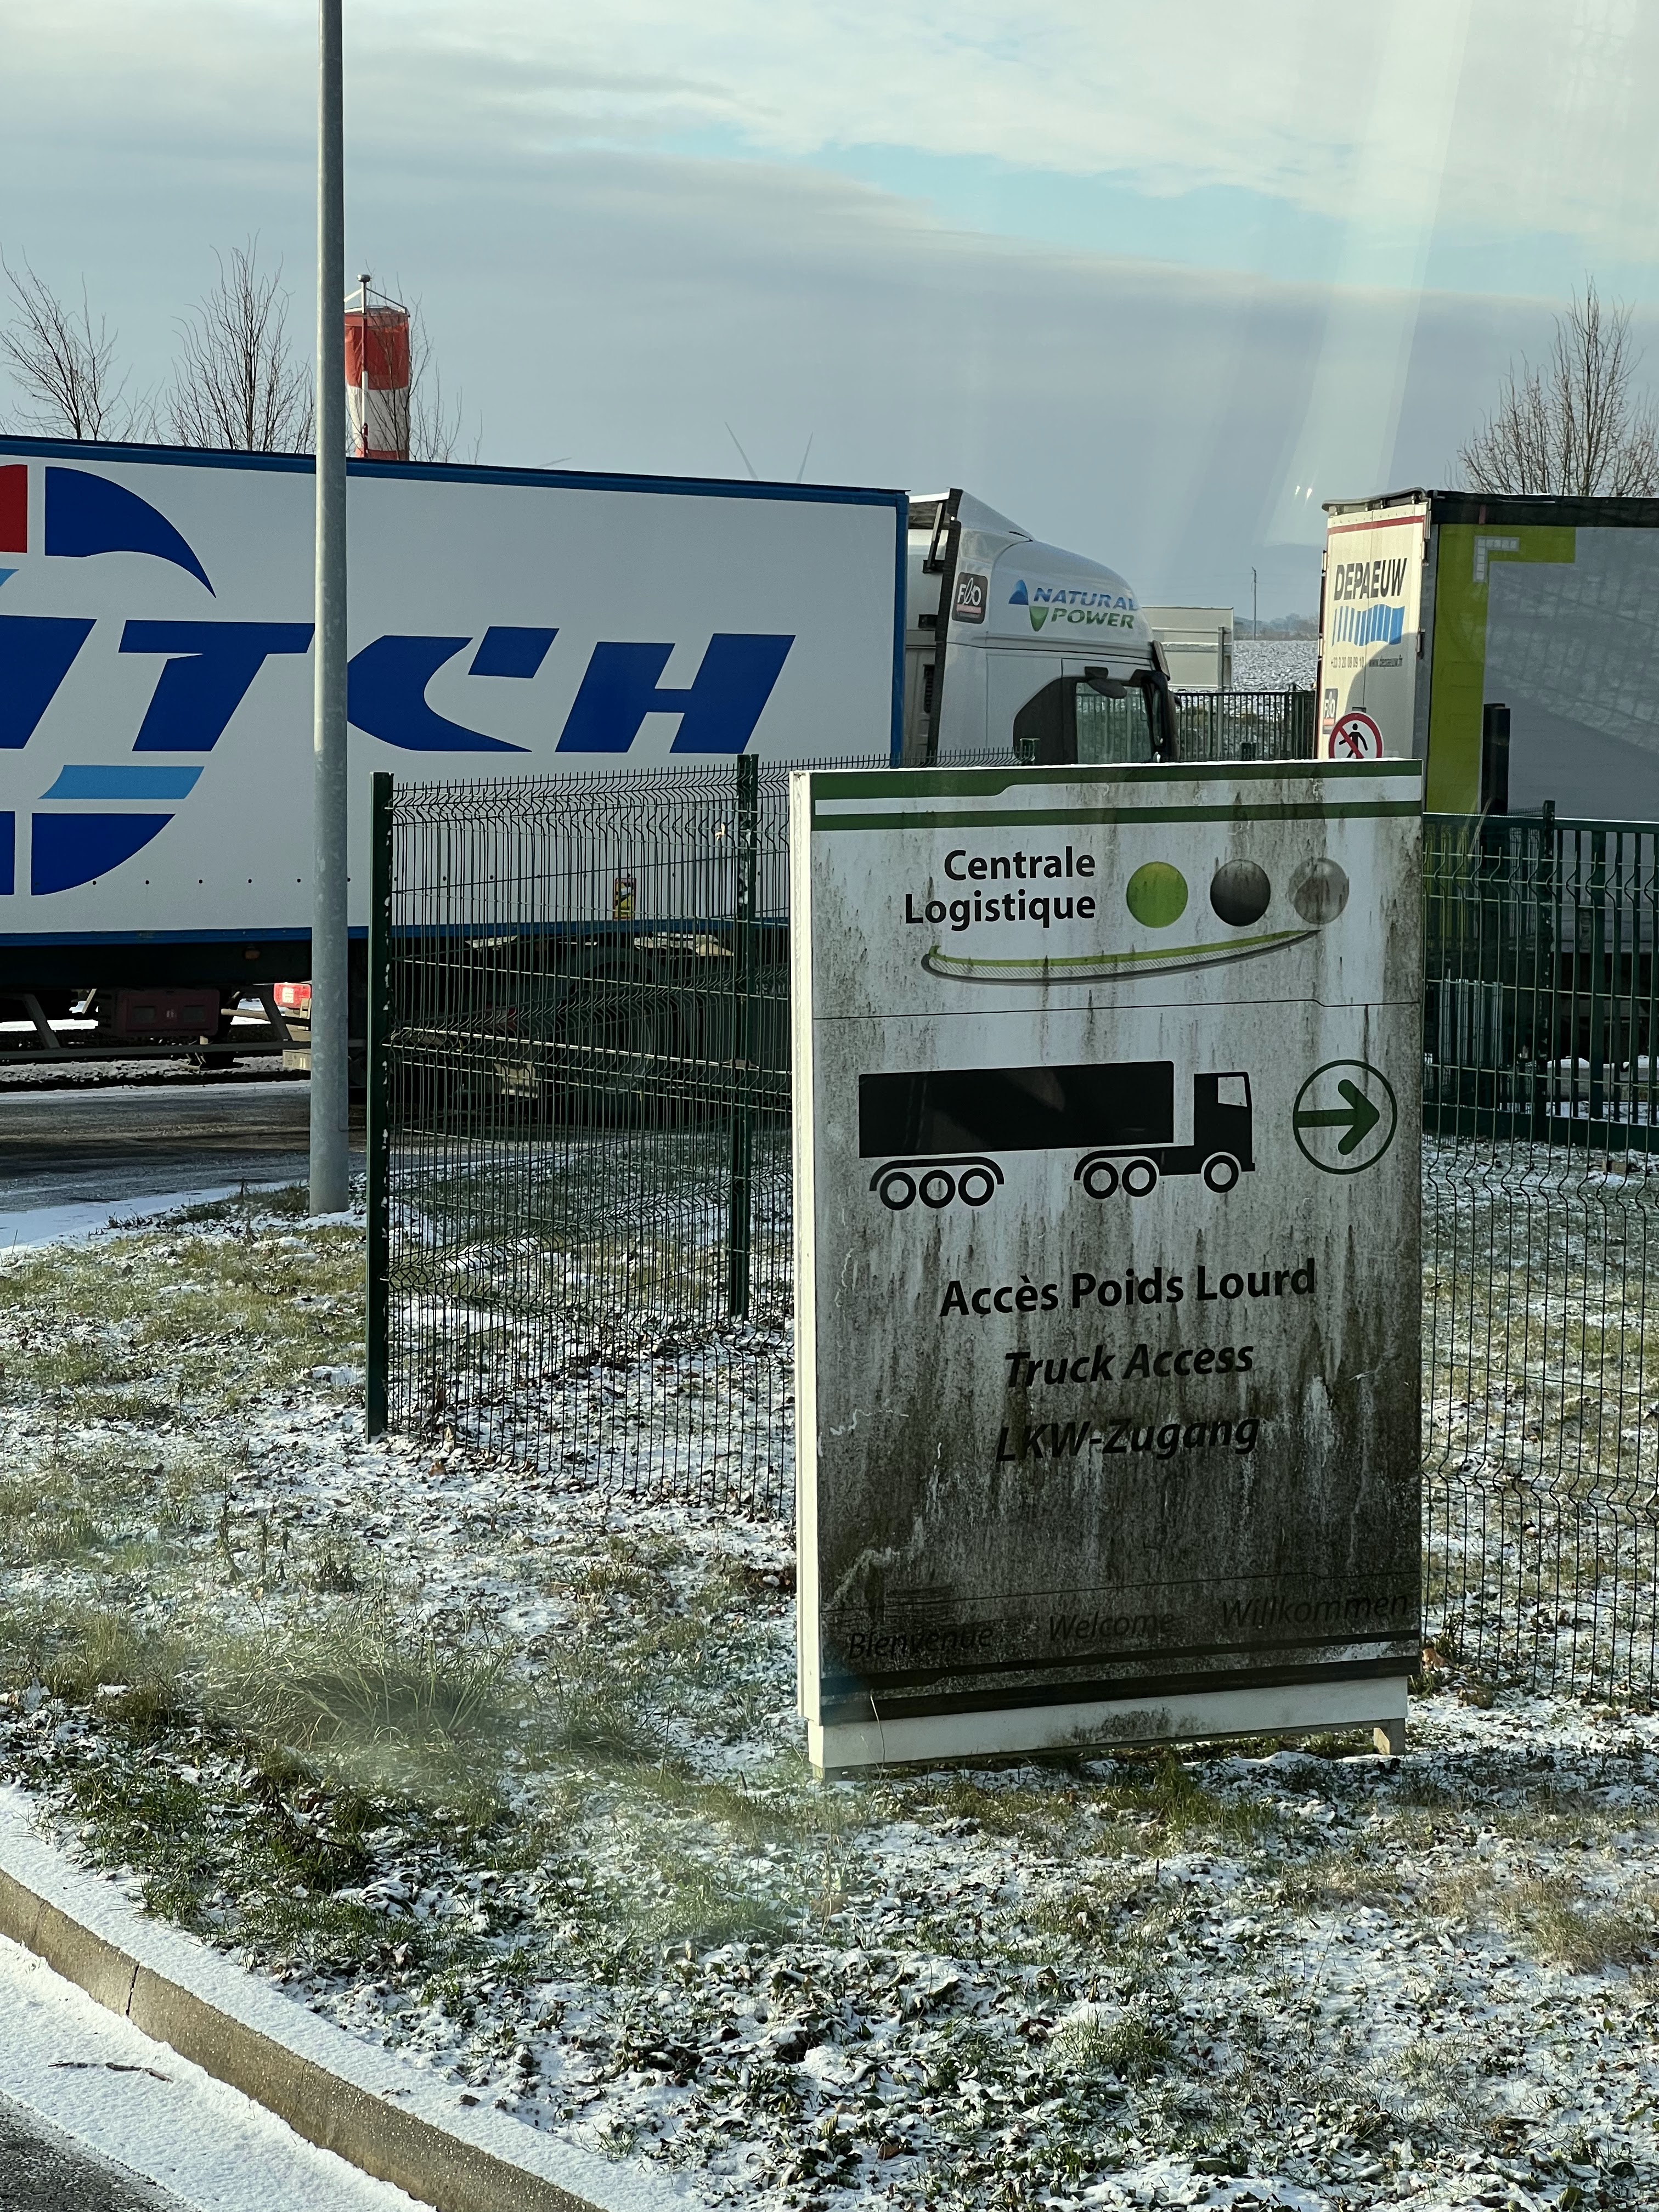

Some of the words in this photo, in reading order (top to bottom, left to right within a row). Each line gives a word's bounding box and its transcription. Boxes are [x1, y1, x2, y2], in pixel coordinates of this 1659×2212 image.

[1034, 588, 1139, 611] NATURAL
[1333, 558, 1408, 601] DEPAEUW
[1051, 608, 1135, 629] POWER
[0, 614, 796, 754] TCH
[944, 845, 1096, 881] Centrale
[905, 888, 1096, 931] Logistique
[940, 1274, 1059, 1317] Accès
[1071, 1267, 1183, 1308] Poids
[1197, 1257, 1316, 1301] Lourd
[1005, 1345, 1116, 1388] Truck
[1121, 1343, 1254, 1380] Access
[995, 1418, 1260, 1463] LKW-Zugang
[849, 1627, 994, 1660] Bienvenue
[1050, 1610, 1175, 1641] Welcome
[1222, 1594, 1408, 1628] Willkommen
